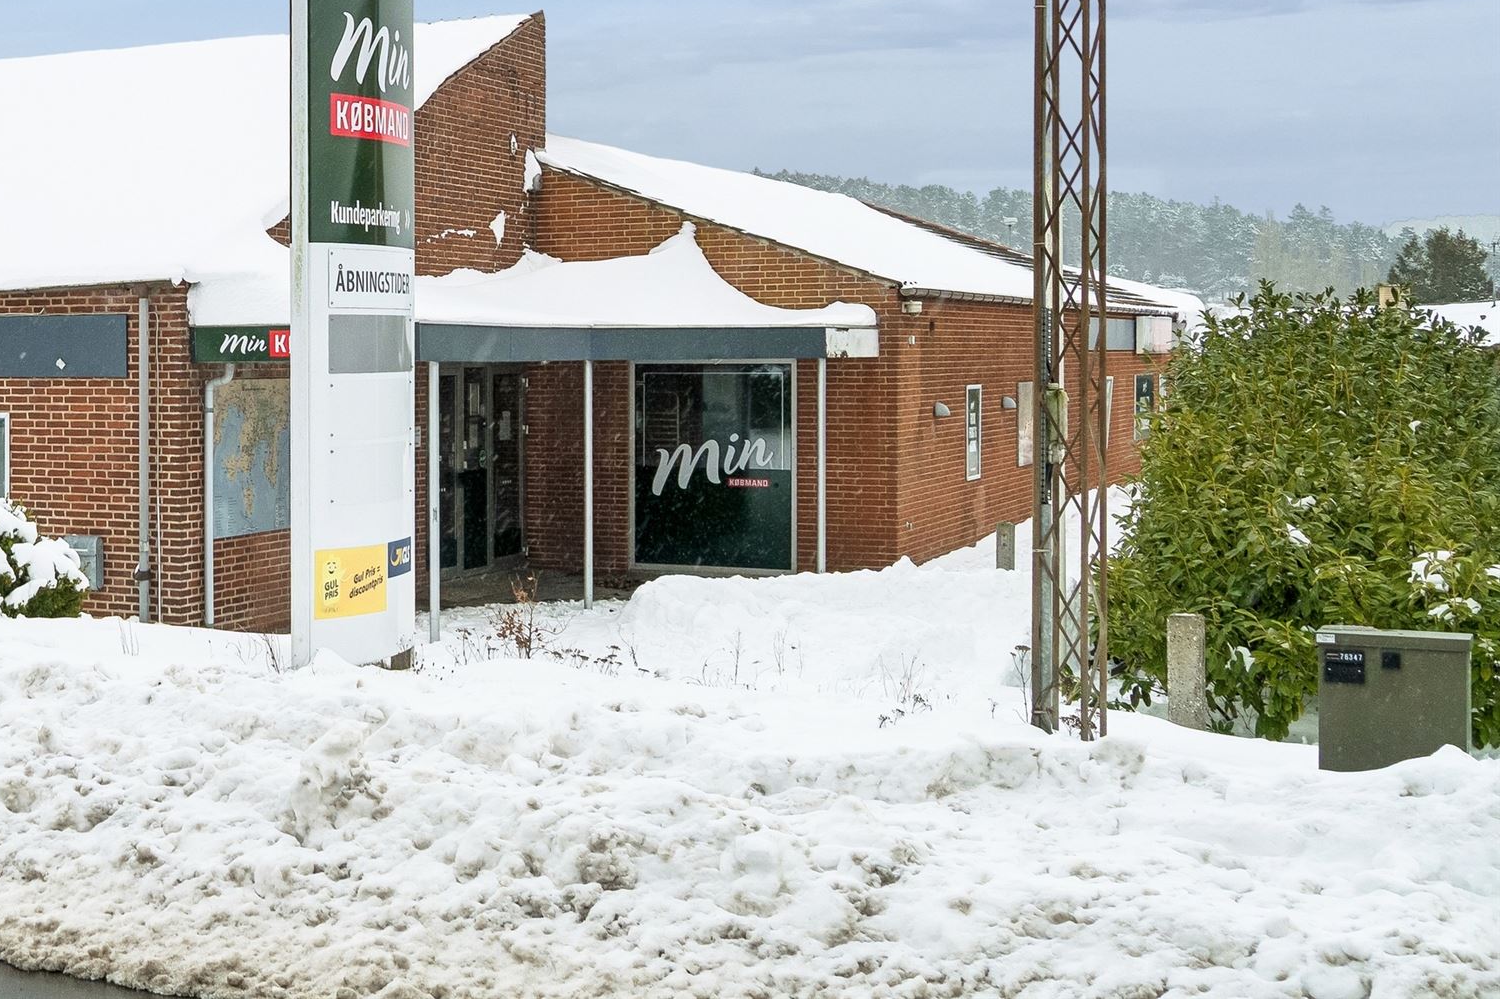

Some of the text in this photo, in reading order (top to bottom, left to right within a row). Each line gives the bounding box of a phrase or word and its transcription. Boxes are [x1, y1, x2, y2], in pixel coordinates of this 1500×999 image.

[330, 11, 410, 93] Min
[336, 100, 408, 141] KØBMAND
[331, 200, 401, 235] Kundeparkering
[335, 264, 409, 294] ÅBNINGSTIDER
[219, 333, 290, 354] Min K
[652, 433, 774, 496] Min
[729, 479, 769, 487] KØBMAND
[324, 579, 339, 592] GUL
[349, 574, 384, 599] discountpris
[353, 572, 365, 584] Gul
[365, 567, 376, 579] Pris
[324, 589, 339, 600] PRIS
